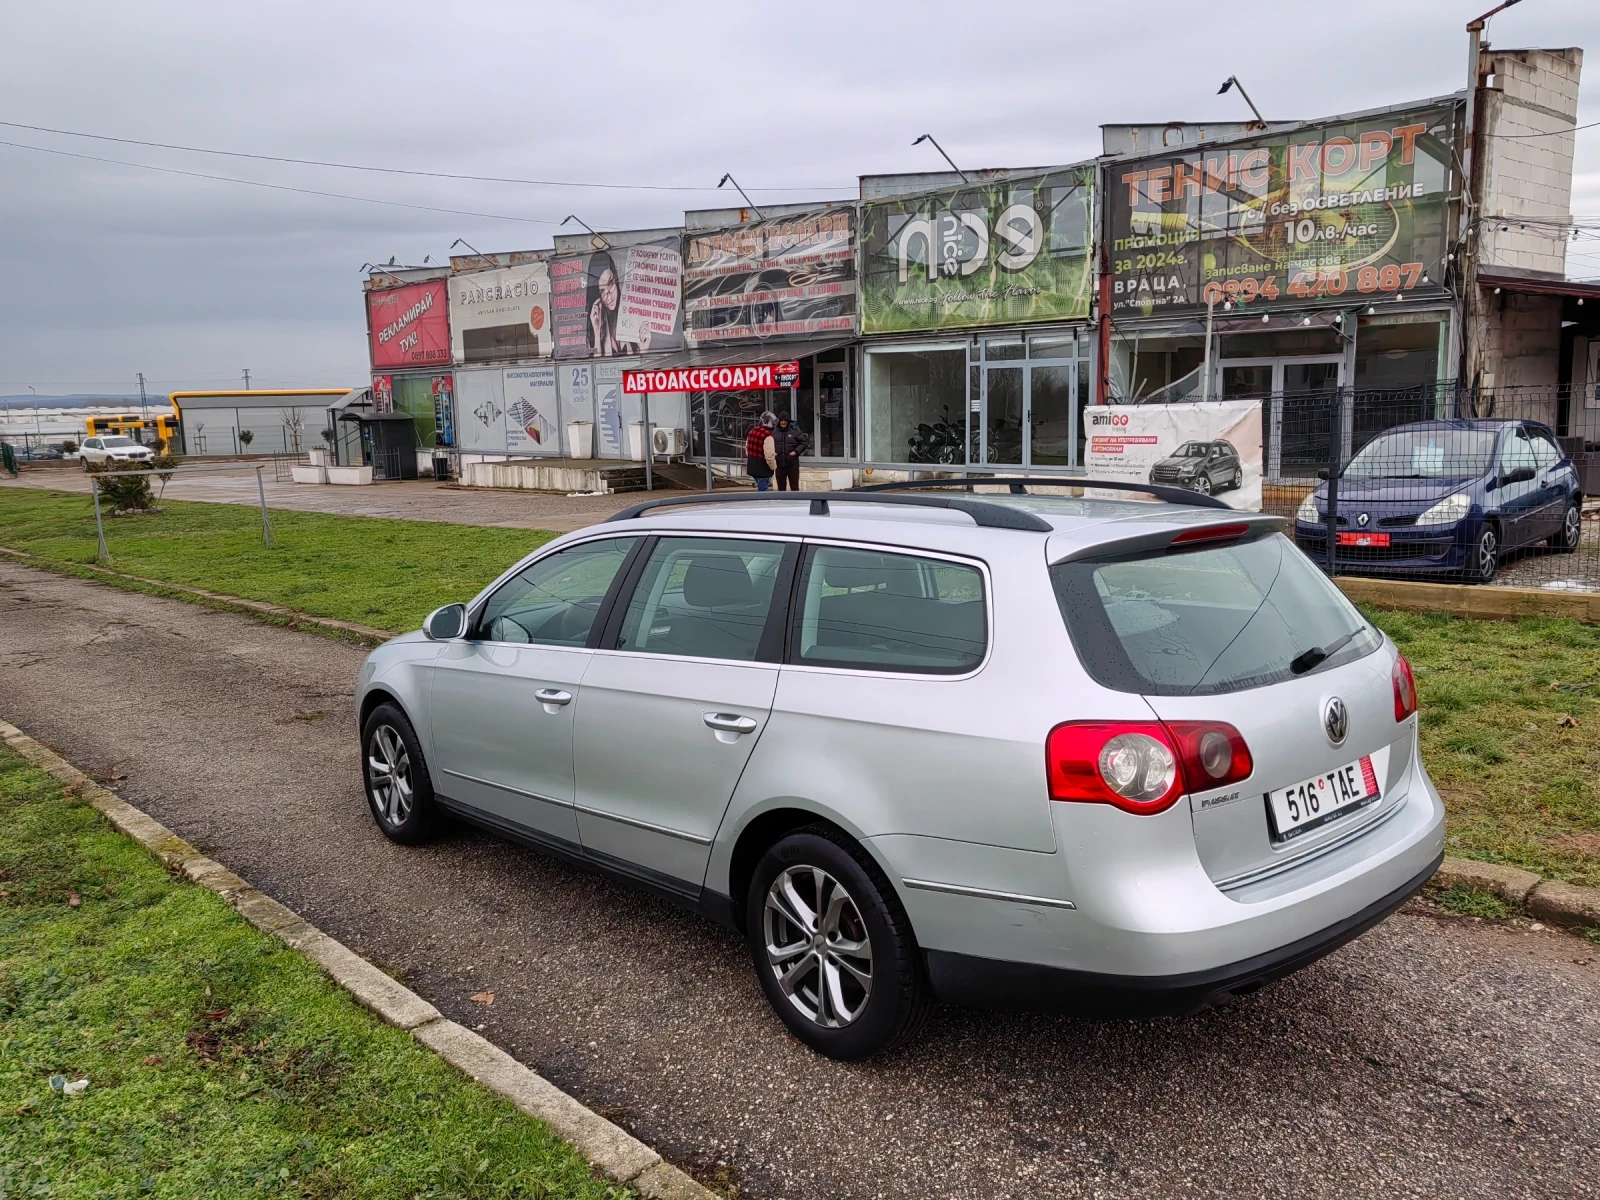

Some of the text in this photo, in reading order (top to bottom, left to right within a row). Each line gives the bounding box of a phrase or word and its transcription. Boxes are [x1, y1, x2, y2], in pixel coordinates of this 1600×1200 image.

[1122, 122, 1427, 206] ТЕНИС КОРТ
[1271, 202, 1298, 216] без
[1302, 182, 1424, 211] ОСВЕТЛЕНИЕ
[688, 212, 849, 263] АВТОАКСЕСОАРИ
[1114, 229, 1200, 251] ПРОМОЦИЯ
[632, 261, 678, 275] ГРАФИЧЕН ДИЗАЙН
[1115, 251, 1188, 275] за 2024г.
[1205, 263, 1271, 280] записване
[1275, 262, 1290, 271] на
[1294, 254, 1346, 268] часове:
[632, 273, 677, 287] ПЕЧАТНА РЕКЛАМА
[1204, 262, 1424, 305] 0894 420 887
[460, 280, 539, 305] PANCRACIO
[627, 295, 652, 306] РЕКЛАМНИ
[631, 284, 675, 299] ВЪНШНА РЕКЛАМА
[942, 289, 975, 305] Follow
[1003, 284, 1042, 300] Flavor
[378, 291, 433, 344] РЕКЛАМИРАЙ
[495, 306, 521, 314] CHOCOLATE
[628, 306, 671, 321] ФИРМЕНИ ПЕЧАТИ
[650, 321, 671, 332] ТЕНИСКИ
[399, 331, 418, 353] ТУК!
[436, 349, 447, 358] 333
[506, 371, 554, 379] ВИСОКОТЕХНОЛОГИЧНИ
[572, 367, 588, 386] 25
[626, 366, 771, 391] АВТОАКСЕСОАРИ
[1285, 782, 1320, 822] 516
[1326, 765, 1360, 805] TAE
